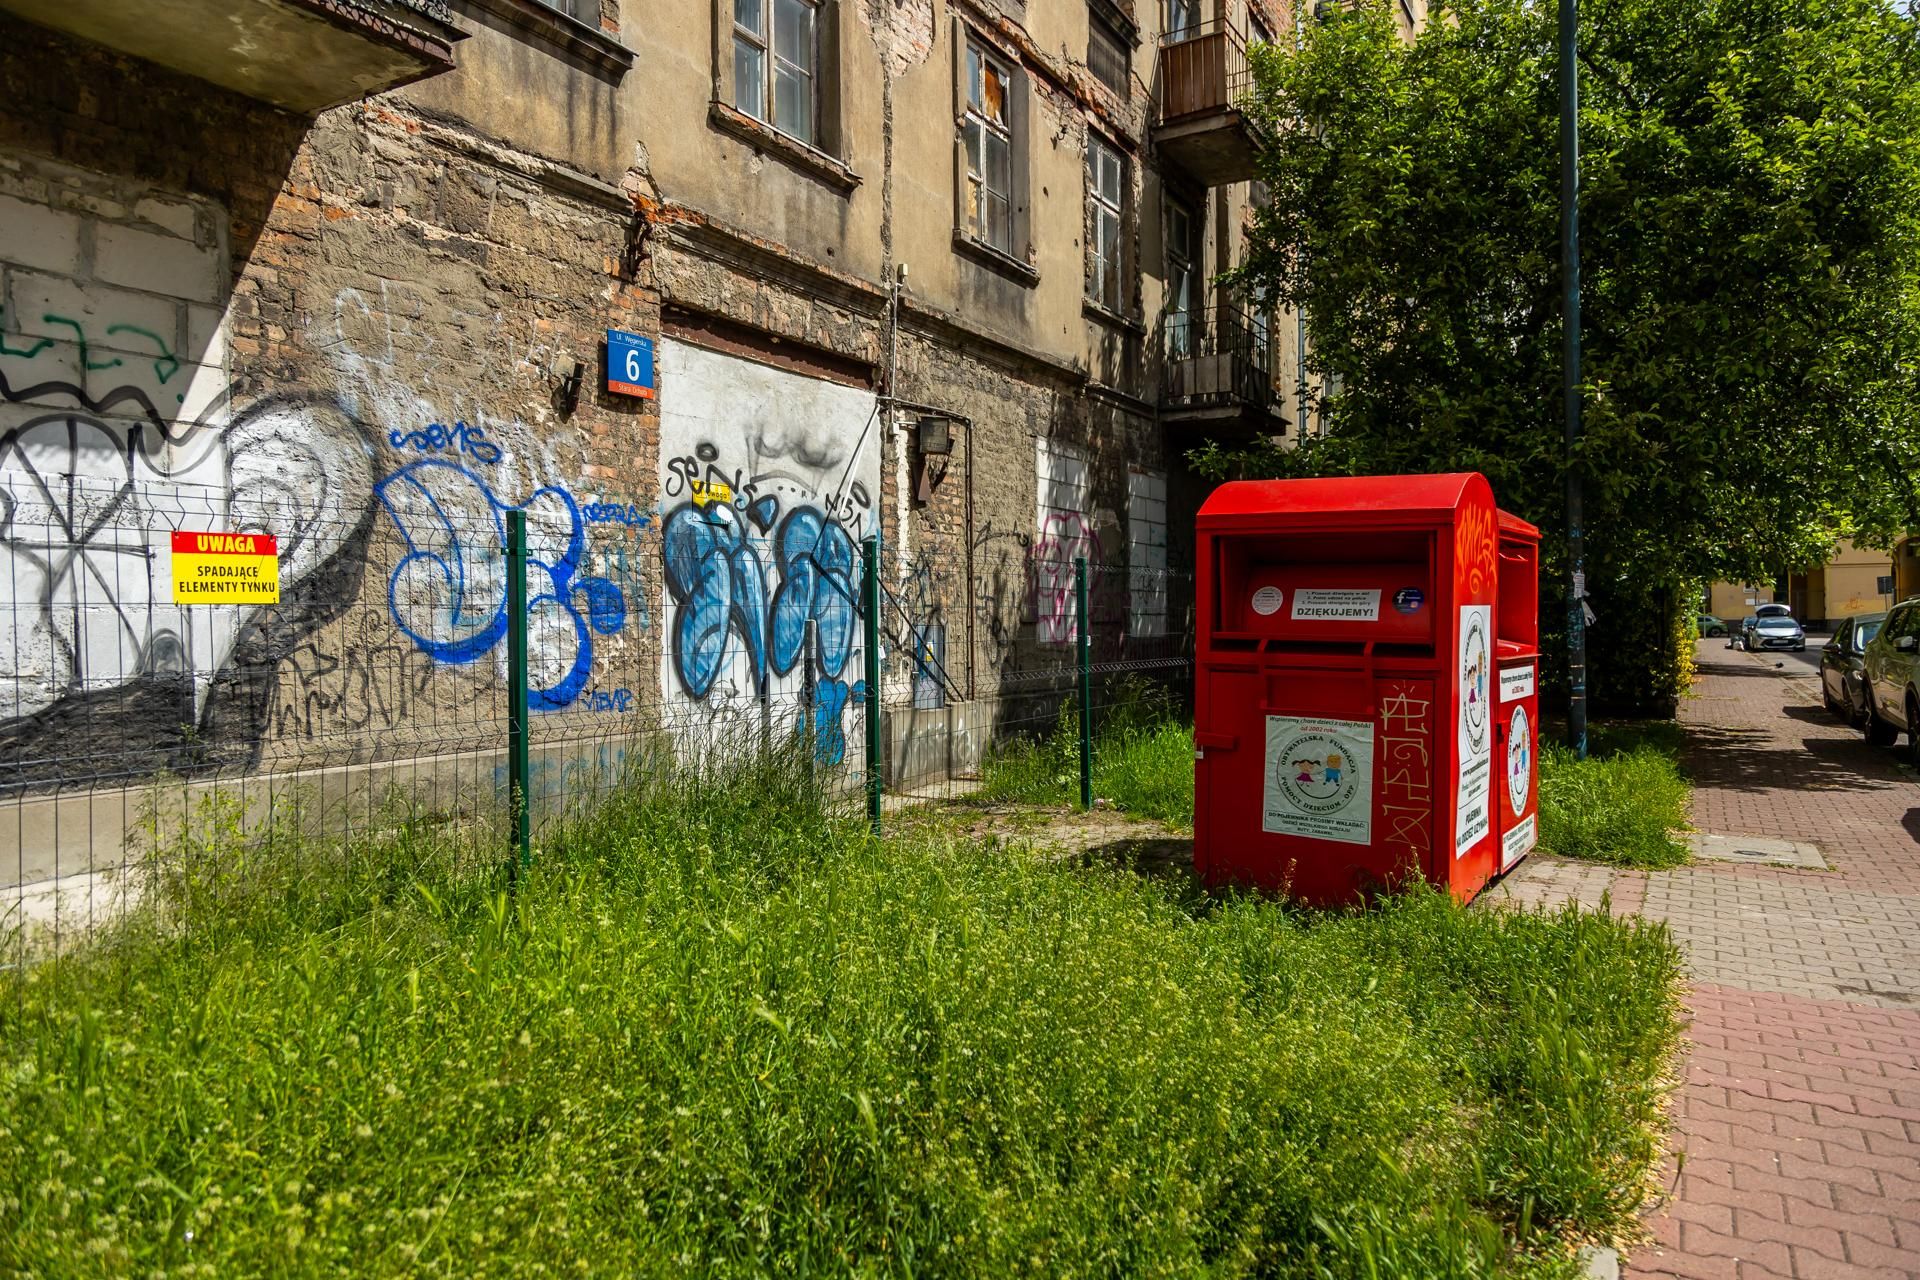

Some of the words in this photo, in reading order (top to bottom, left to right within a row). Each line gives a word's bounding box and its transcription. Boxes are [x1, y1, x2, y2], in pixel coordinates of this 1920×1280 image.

[626, 349, 640, 382] 6
[197, 535, 256, 553] UWAGA
[197, 566, 258, 580] SPADAJĄCE
[179, 581, 238, 593] ELEMENTY
[240, 582, 275, 593] TYNKU
[1297, 608, 1373, 617] DZIĘKUJEMY!
[1281, 735, 1324, 766] OBYWATELSKA
[1329, 739, 1356, 774] FUNDACJA
[1303, 801, 1341, 812] DZIECIOM
